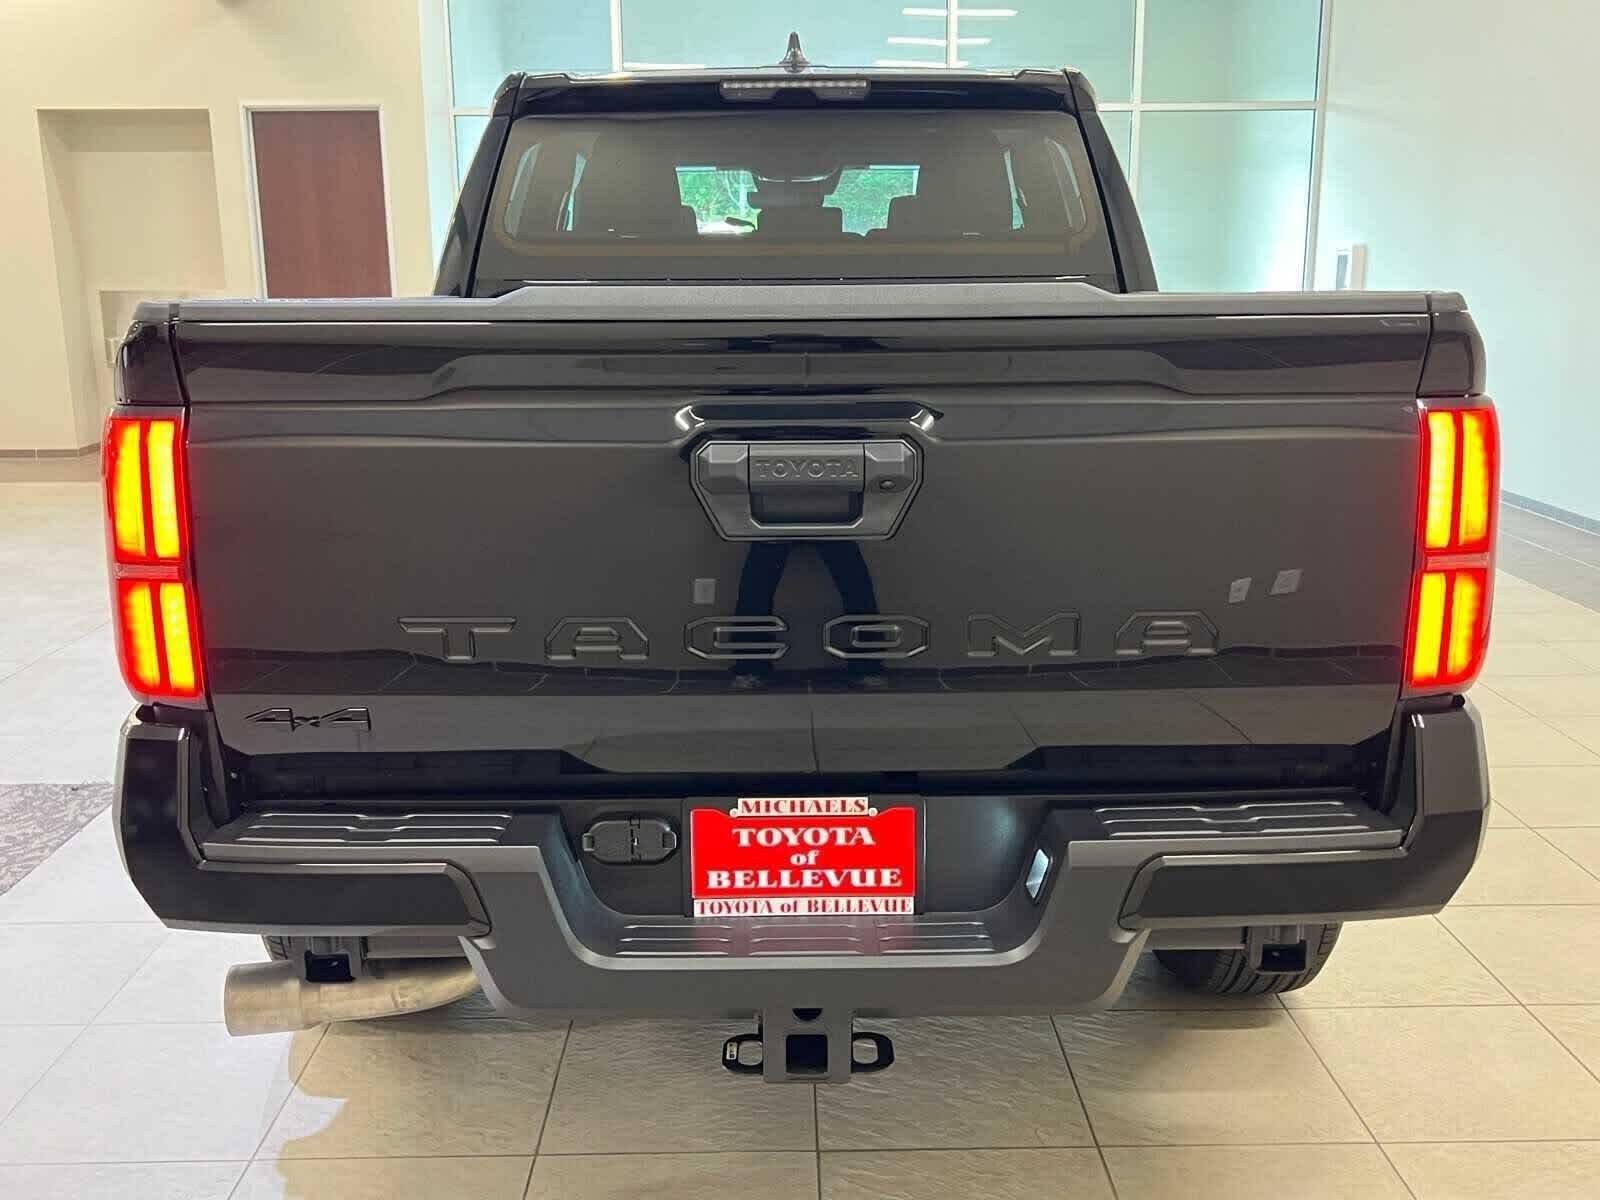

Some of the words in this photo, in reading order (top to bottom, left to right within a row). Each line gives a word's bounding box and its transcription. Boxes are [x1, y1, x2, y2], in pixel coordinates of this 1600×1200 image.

[754, 461, 859, 479] TOYOTA
[398, 609, 1220, 661] TACOMA
[740, 798, 866, 815] MICHAELS
[732, 826, 876, 847] TOYOTA
[789, 850, 819, 866] of
[706, 868, 903, 889] BELLEVUE
[695, 900, 775, 916] TOYOTA
[780, 900, 799, 913] of
[806, 898, 912, 913] BELLEVUE
